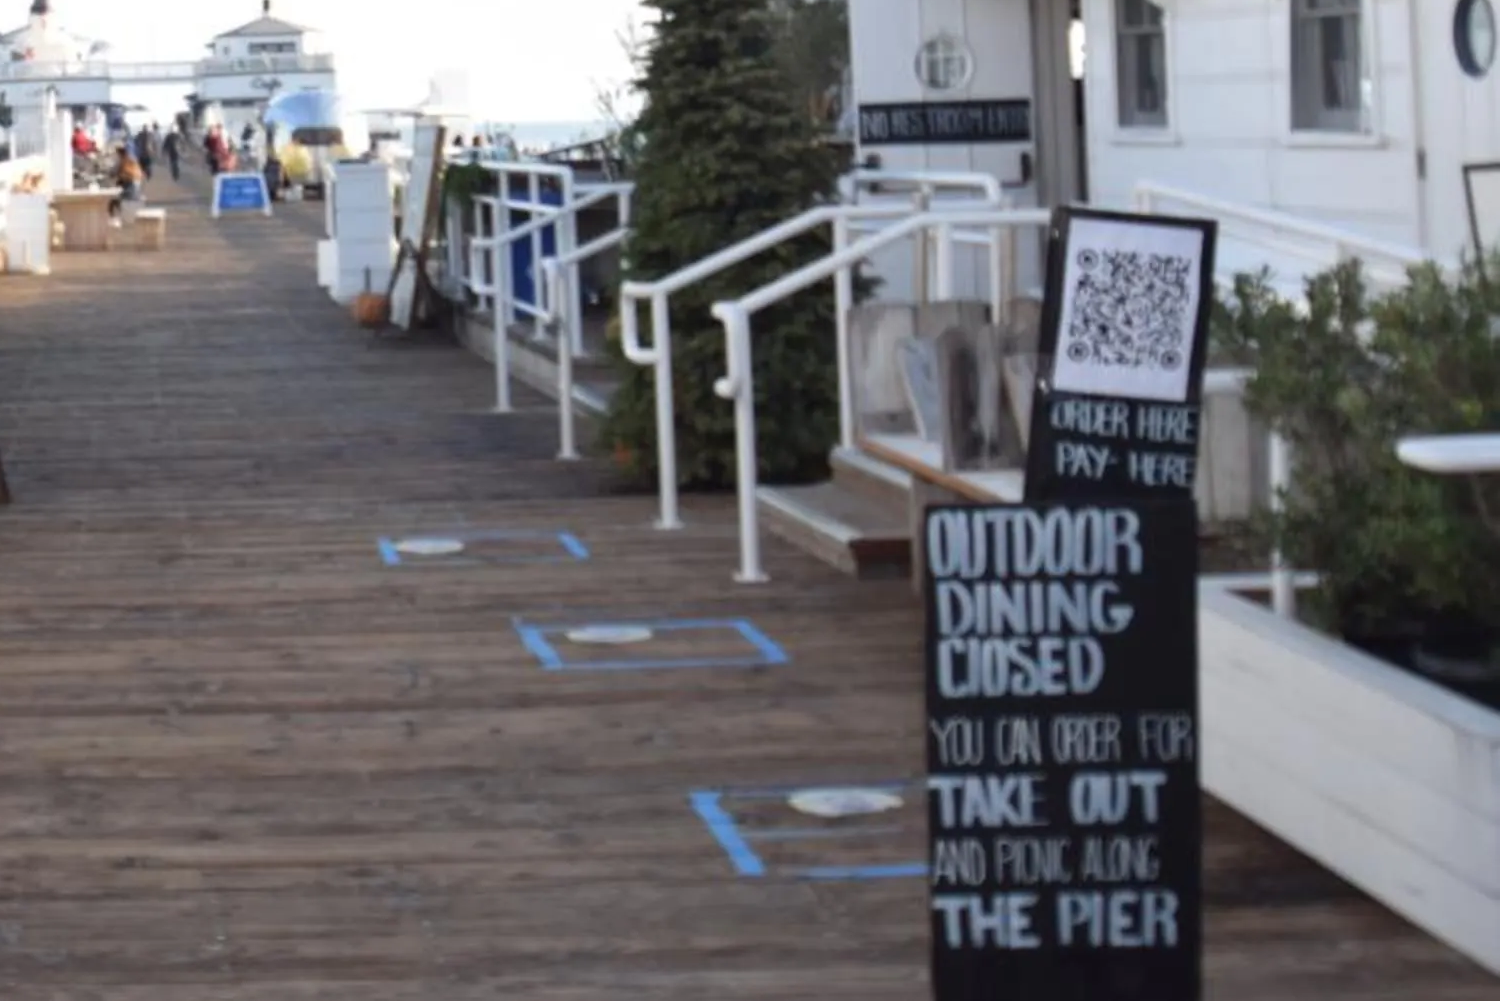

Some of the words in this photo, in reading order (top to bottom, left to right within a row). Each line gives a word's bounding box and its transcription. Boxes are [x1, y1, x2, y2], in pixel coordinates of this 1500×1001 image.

[1051, 399, 1130, 439] ORDER
[1136, 404, 1198, 444] HERE
[1129, 450, 1196, 488] HERE
[927, 507, 1143, 579] OUTDOOR
[934, 579, 1134, 636] DINING
[936, 636, 1106, 698] CLOSED
[930, 715, 985, 766] YOU
[994, 714, 1043, 766] CAN
[1052, 712, 1122, 764] ORDER
[1137, 711, 1195, 763] FOR
[927, 771, 1049, 829] TAKE
[1068, 767, 1168, 825] OUT
[933, 836, 987, 887] AND
[1080, 834, 1162, 883] ALONG
[932, 892, 1042, 949] THE
[1056, 889, 1180, 947] PIER
